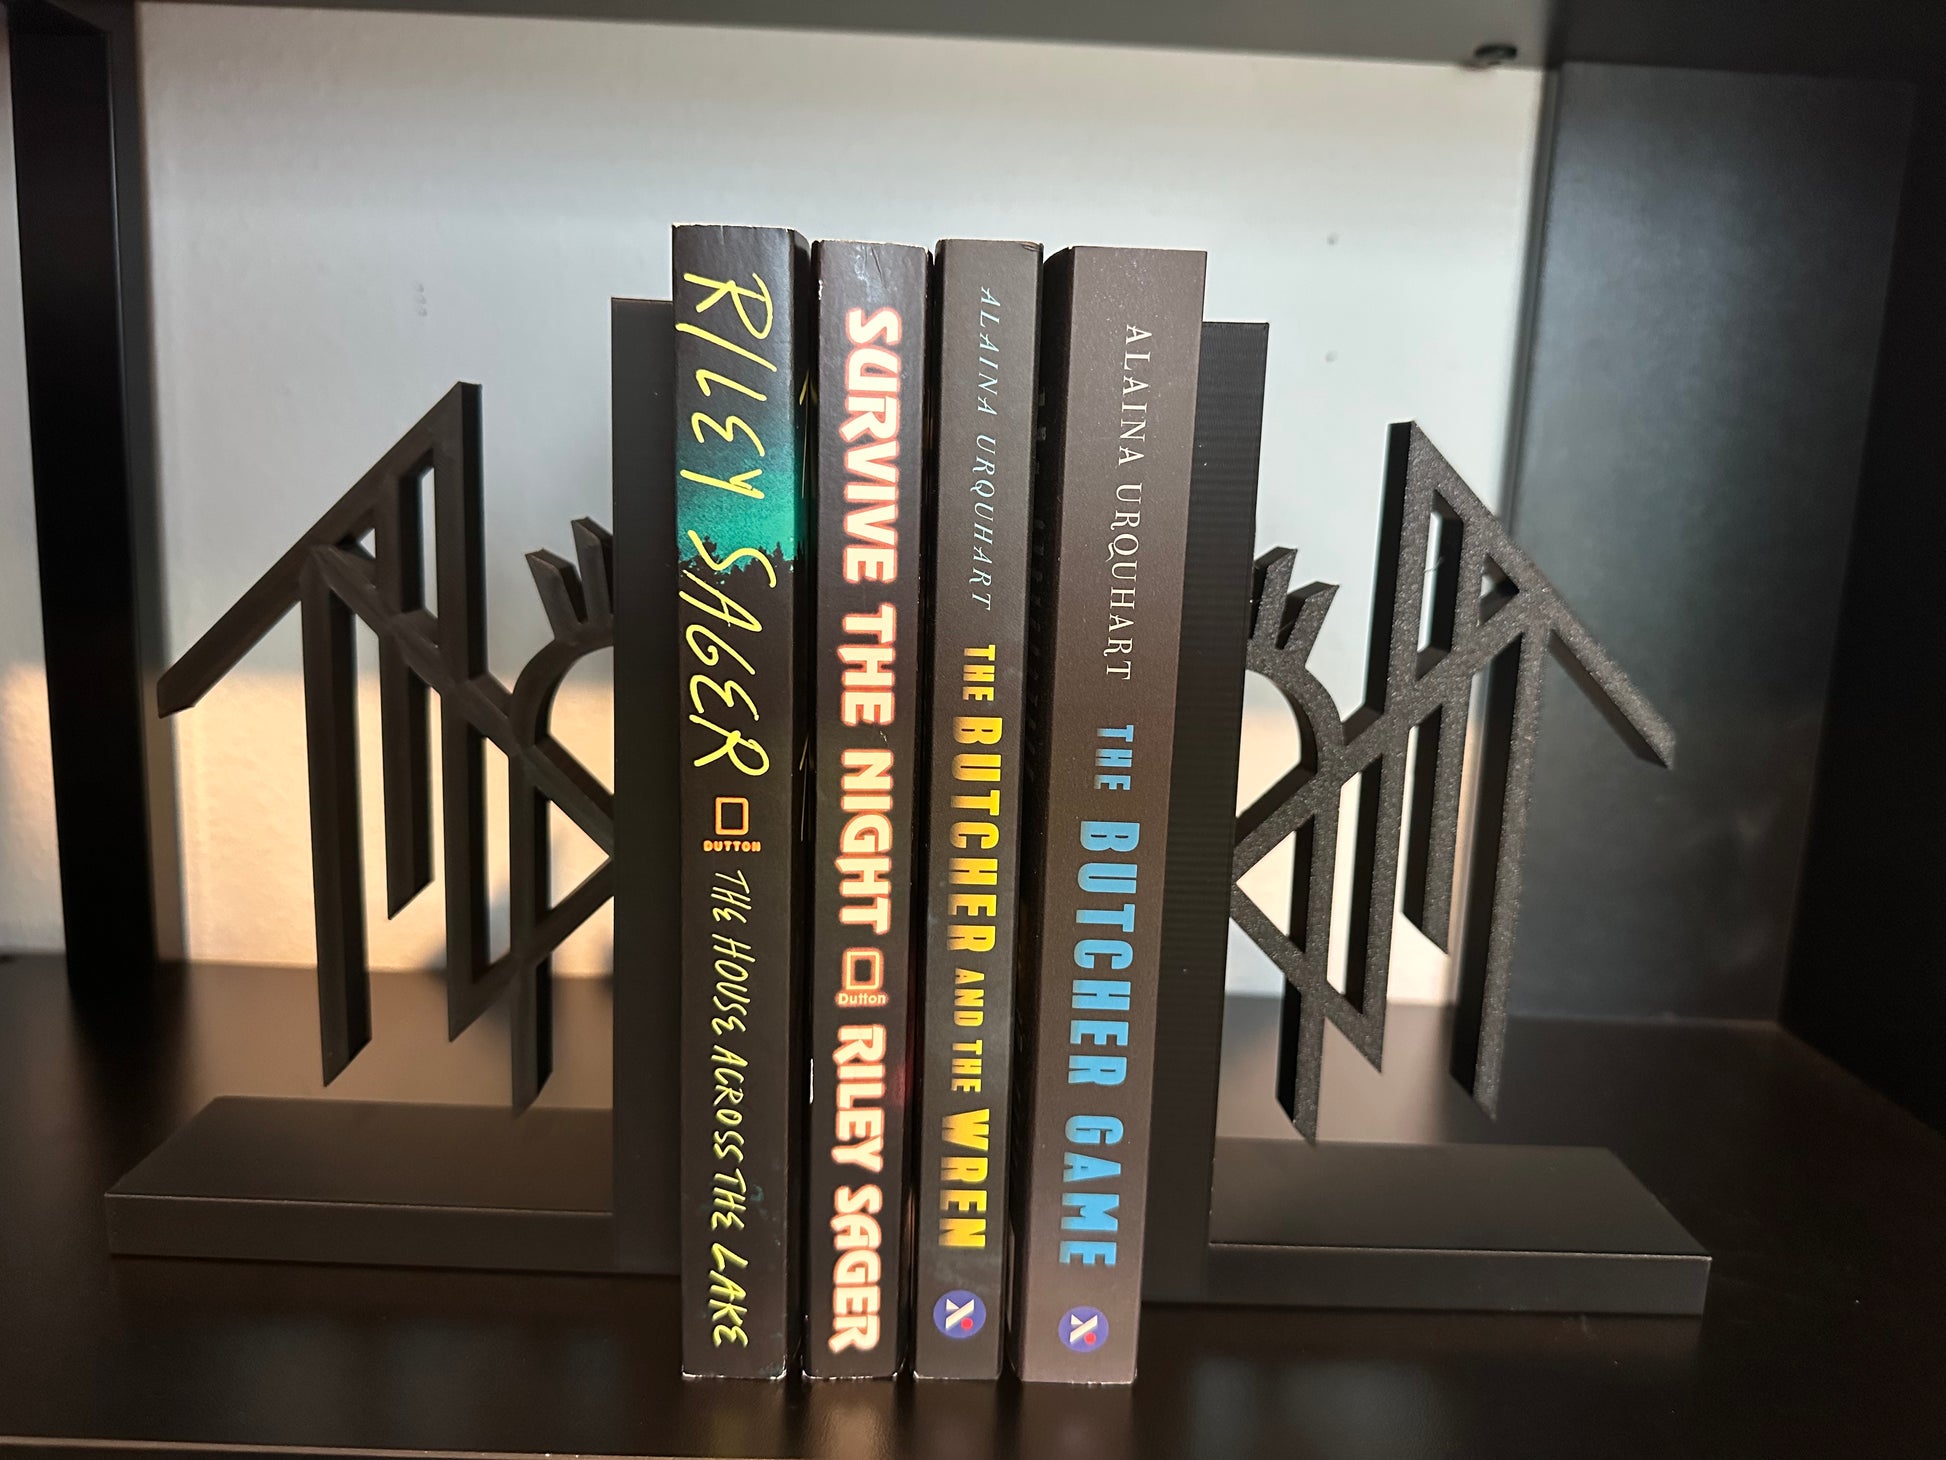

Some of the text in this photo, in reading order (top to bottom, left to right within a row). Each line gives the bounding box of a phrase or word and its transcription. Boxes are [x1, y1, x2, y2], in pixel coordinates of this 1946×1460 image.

[675, 272, 778, 777] RILEY SAGER
[835, 307, 902, 935] SURVIVE THE NIGHT
[968, 286, 1001, 611] ALAINA URQUHART
[1104, 324, 1153, 681] ALAINA URQUHART
[702, 840, 762, 853] DUTTON
[836, 991, 888, 1007] Dutton
[938, 644, 1003, 1249] THE BUTCHER AND THE WREN
[1058, 724, 1141, 1268] THE BUTCHER GAME
[710, 869, 756, 1349] THE HOUSE ACROSS THE LAKE
[828, 1024, 887, 1355] RILEY SAGER
